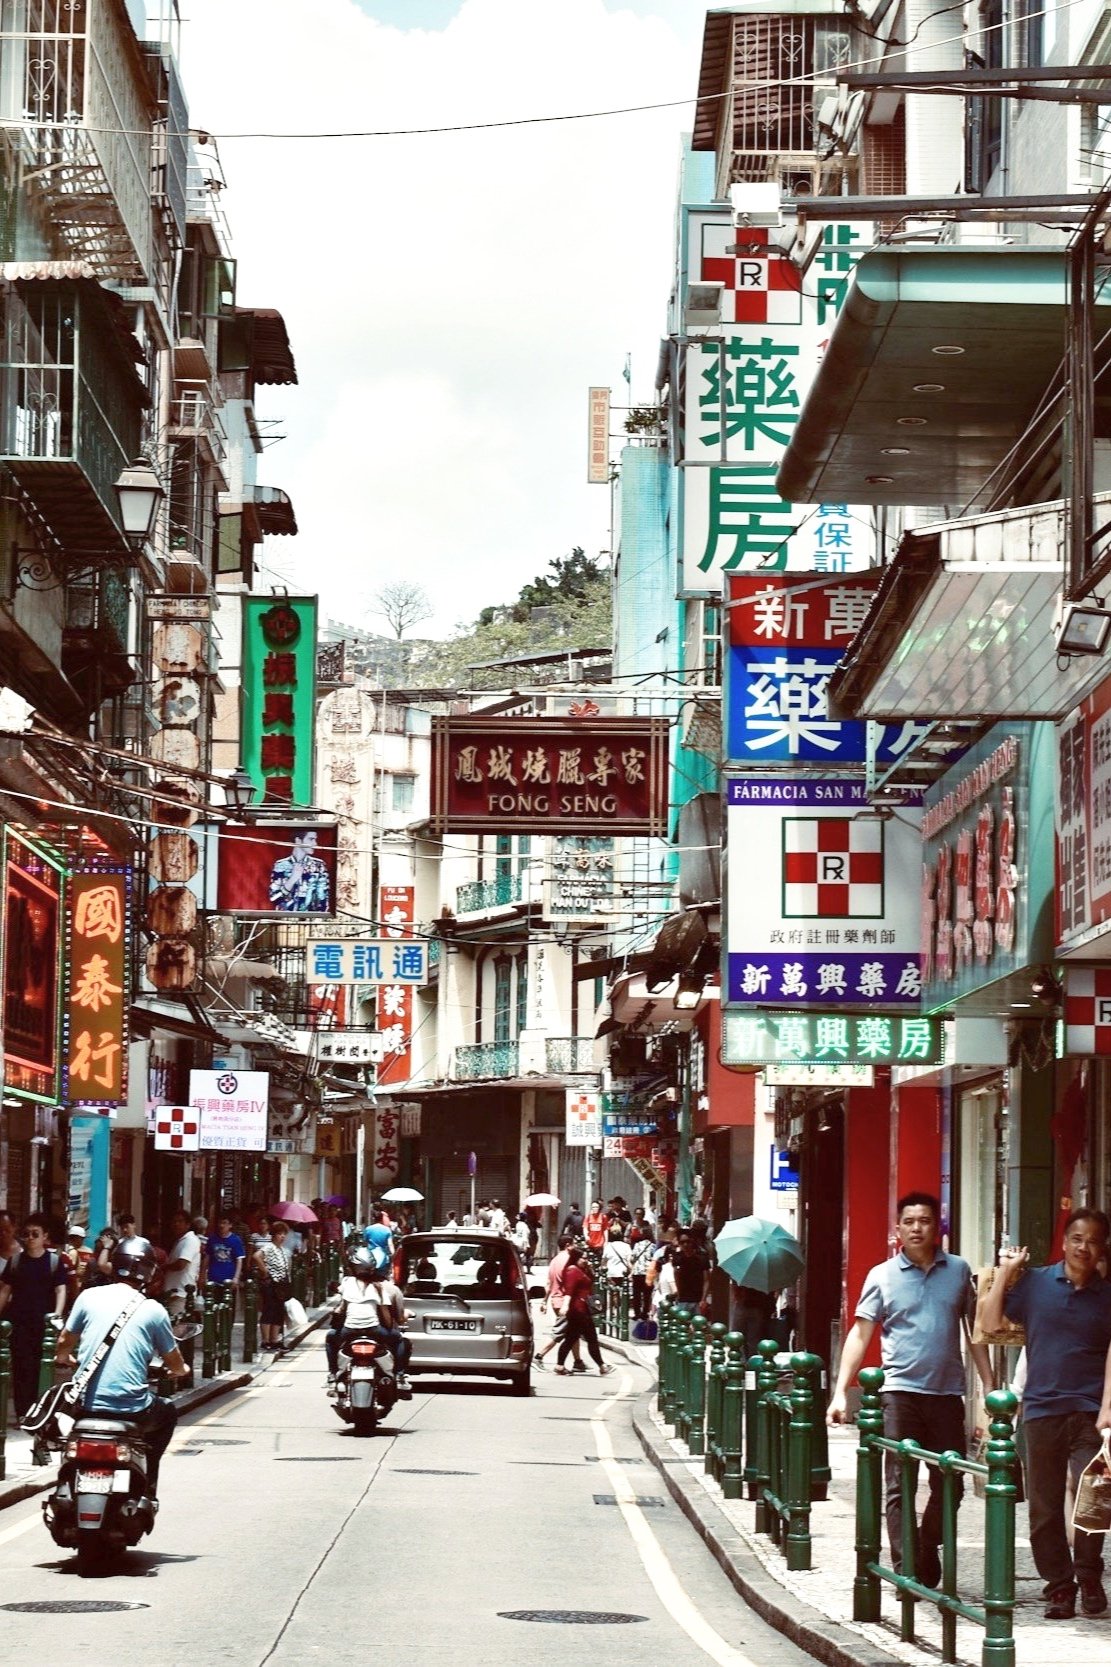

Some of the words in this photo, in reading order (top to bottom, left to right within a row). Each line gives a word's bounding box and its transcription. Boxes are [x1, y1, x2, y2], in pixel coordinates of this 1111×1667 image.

[697, 337, 801, 573] 藥房
[455, 745, 646, 786] 鳳城燒臘專家
[488, 795, 549, 812] FONG
[560, 796, 617, 813] SENG
[733, 782, 808, 799] FÁRMACIA
[815, 786, 844, 799] SAN
[770, 929, 896, 944] 政府註冊藥劑師
[313, 944, 424, 980] 電訊通
[740, 962, 922, 997] 新萬興藥房
[70, 886, 122, 1088] 國泰行
[733, 1017, 932, 1058] 新萬興藥房
